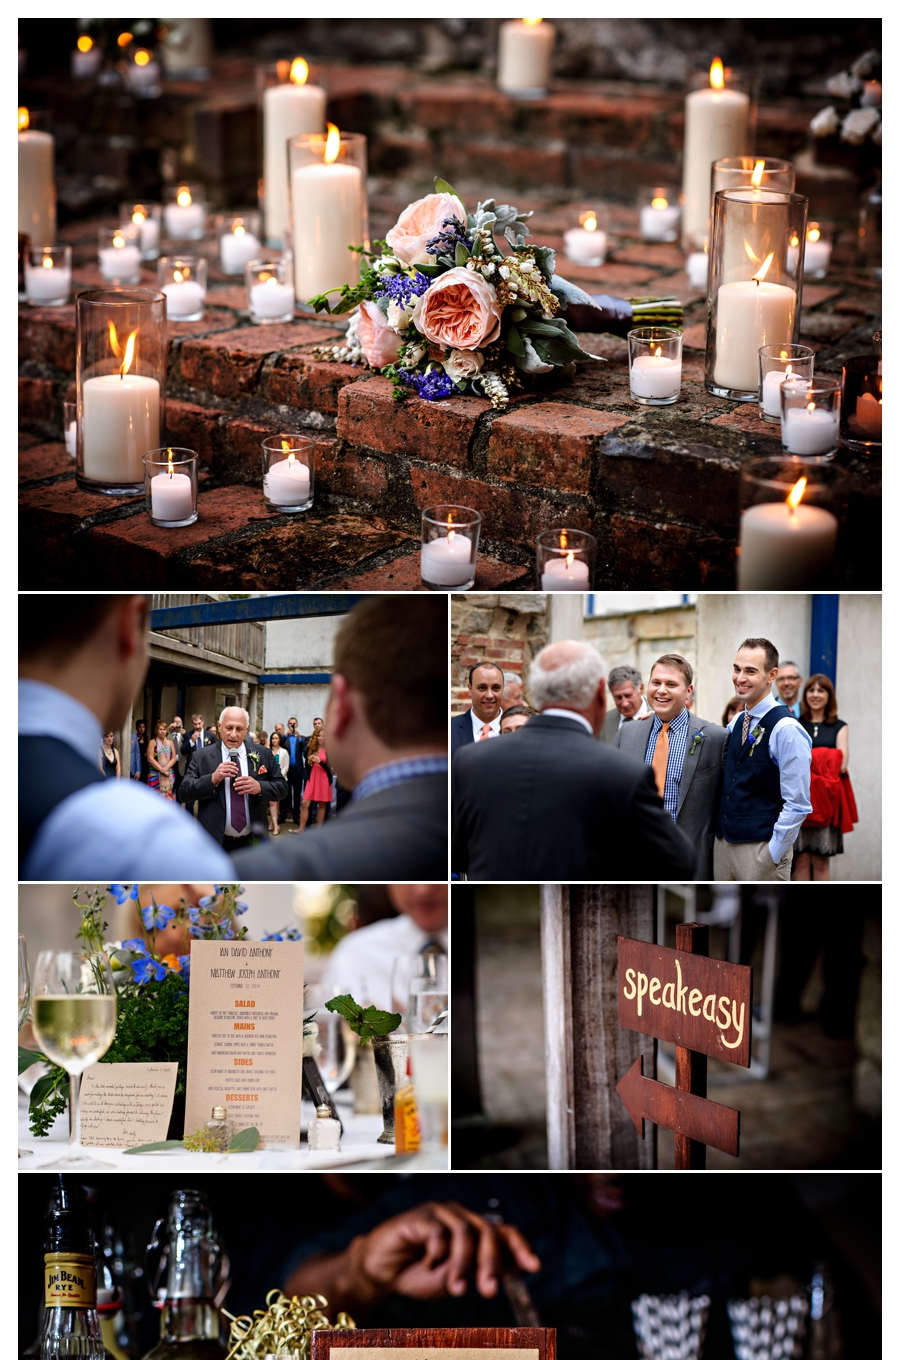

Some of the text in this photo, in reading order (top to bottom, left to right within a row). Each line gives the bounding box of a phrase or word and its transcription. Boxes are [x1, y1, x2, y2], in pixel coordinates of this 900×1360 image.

[220, 948, 273, 957] IAN DAVID ANTHONY
[211, 968, 281, 978] MATTHEW JOSEPH ANTHONY
[624, 959, 745, 1049] speakeasy
[48, 1270, 86, 1290] JIM BEAM
